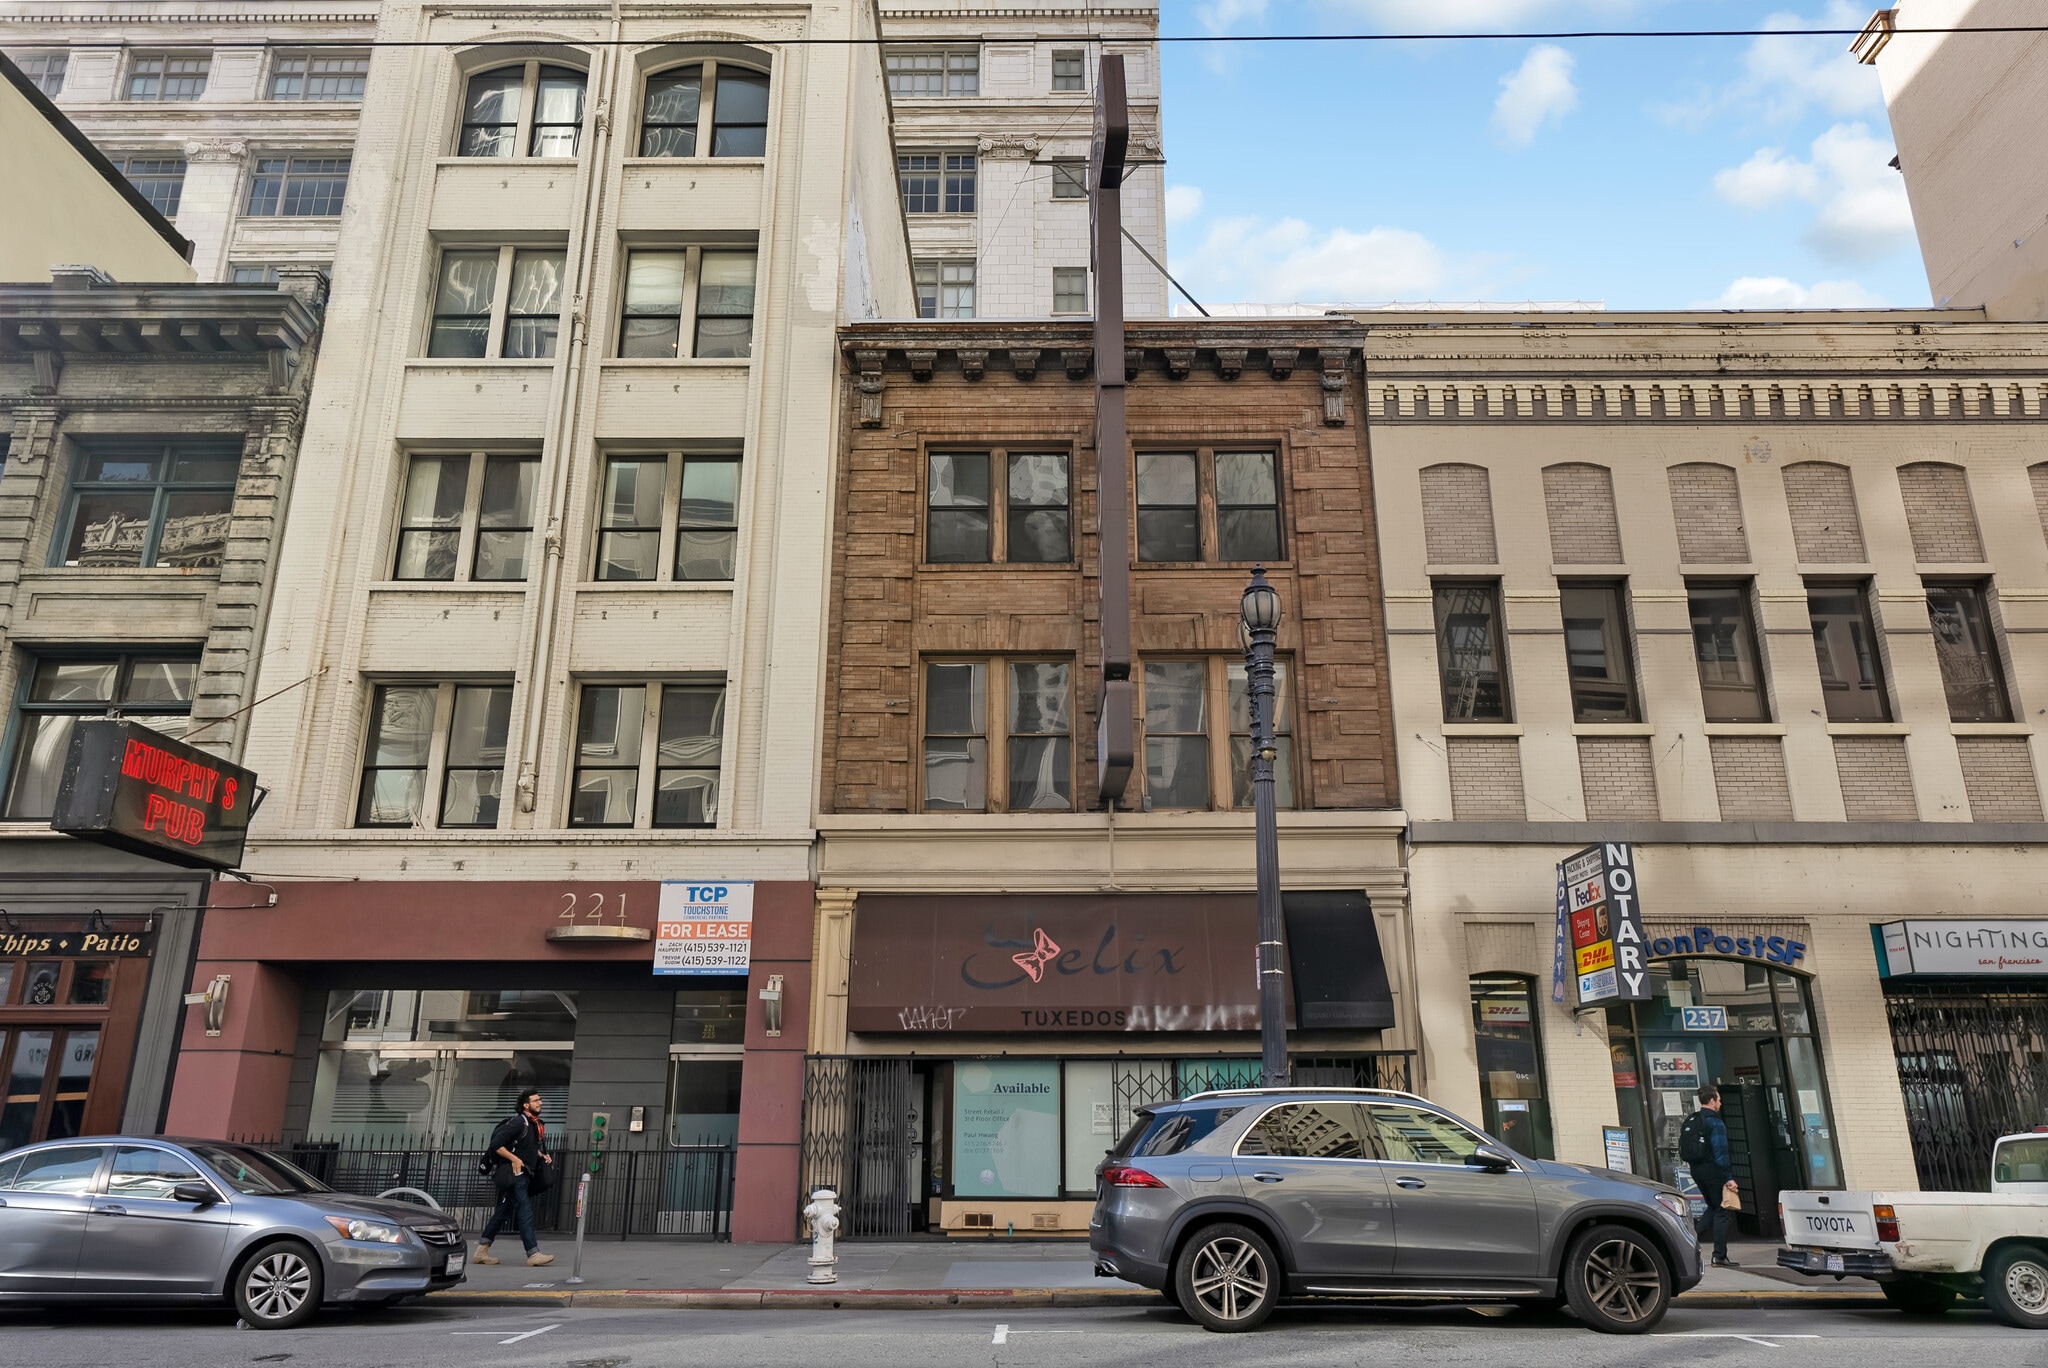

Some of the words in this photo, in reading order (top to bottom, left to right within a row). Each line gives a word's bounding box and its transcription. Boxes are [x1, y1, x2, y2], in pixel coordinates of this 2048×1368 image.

[122, 739, 219, 803] MURPHY
[144, 794, 205, 845] PUB
[686, 887, 728, 903] TCP
[1575, 881, 1601, 907] FedEx
[559, 893, 628, 919] 221
[683, 906, 728, 915] TOUCHSTONE
[1576, 918, 1590, 929] Shipping
[1605, 844, 1644, 996] NOTARY
[661, 924, 692, 938] FOR
[696, 924, 749, 938] LEASE
[1579, 929, 1591, 939] Center
[80, 933, 140, 952] Patio
[1582, 947, 1609, 967] DHL
[1998, 956, 2043, 970] francisco
[1021, 1010, 1126, 1027] TUXEDOS
[1488, 1006, 1522, 1015] DHL
[1686, 1010, 1723, 1027] 237
[1653, 1058, 1693, 1071] FedEx
[994, 1083, 1050, 1094] Available
[978, 1132, 998, 1140] Hwang
[1806, 1216, 1855, 1233] TOYOTA
